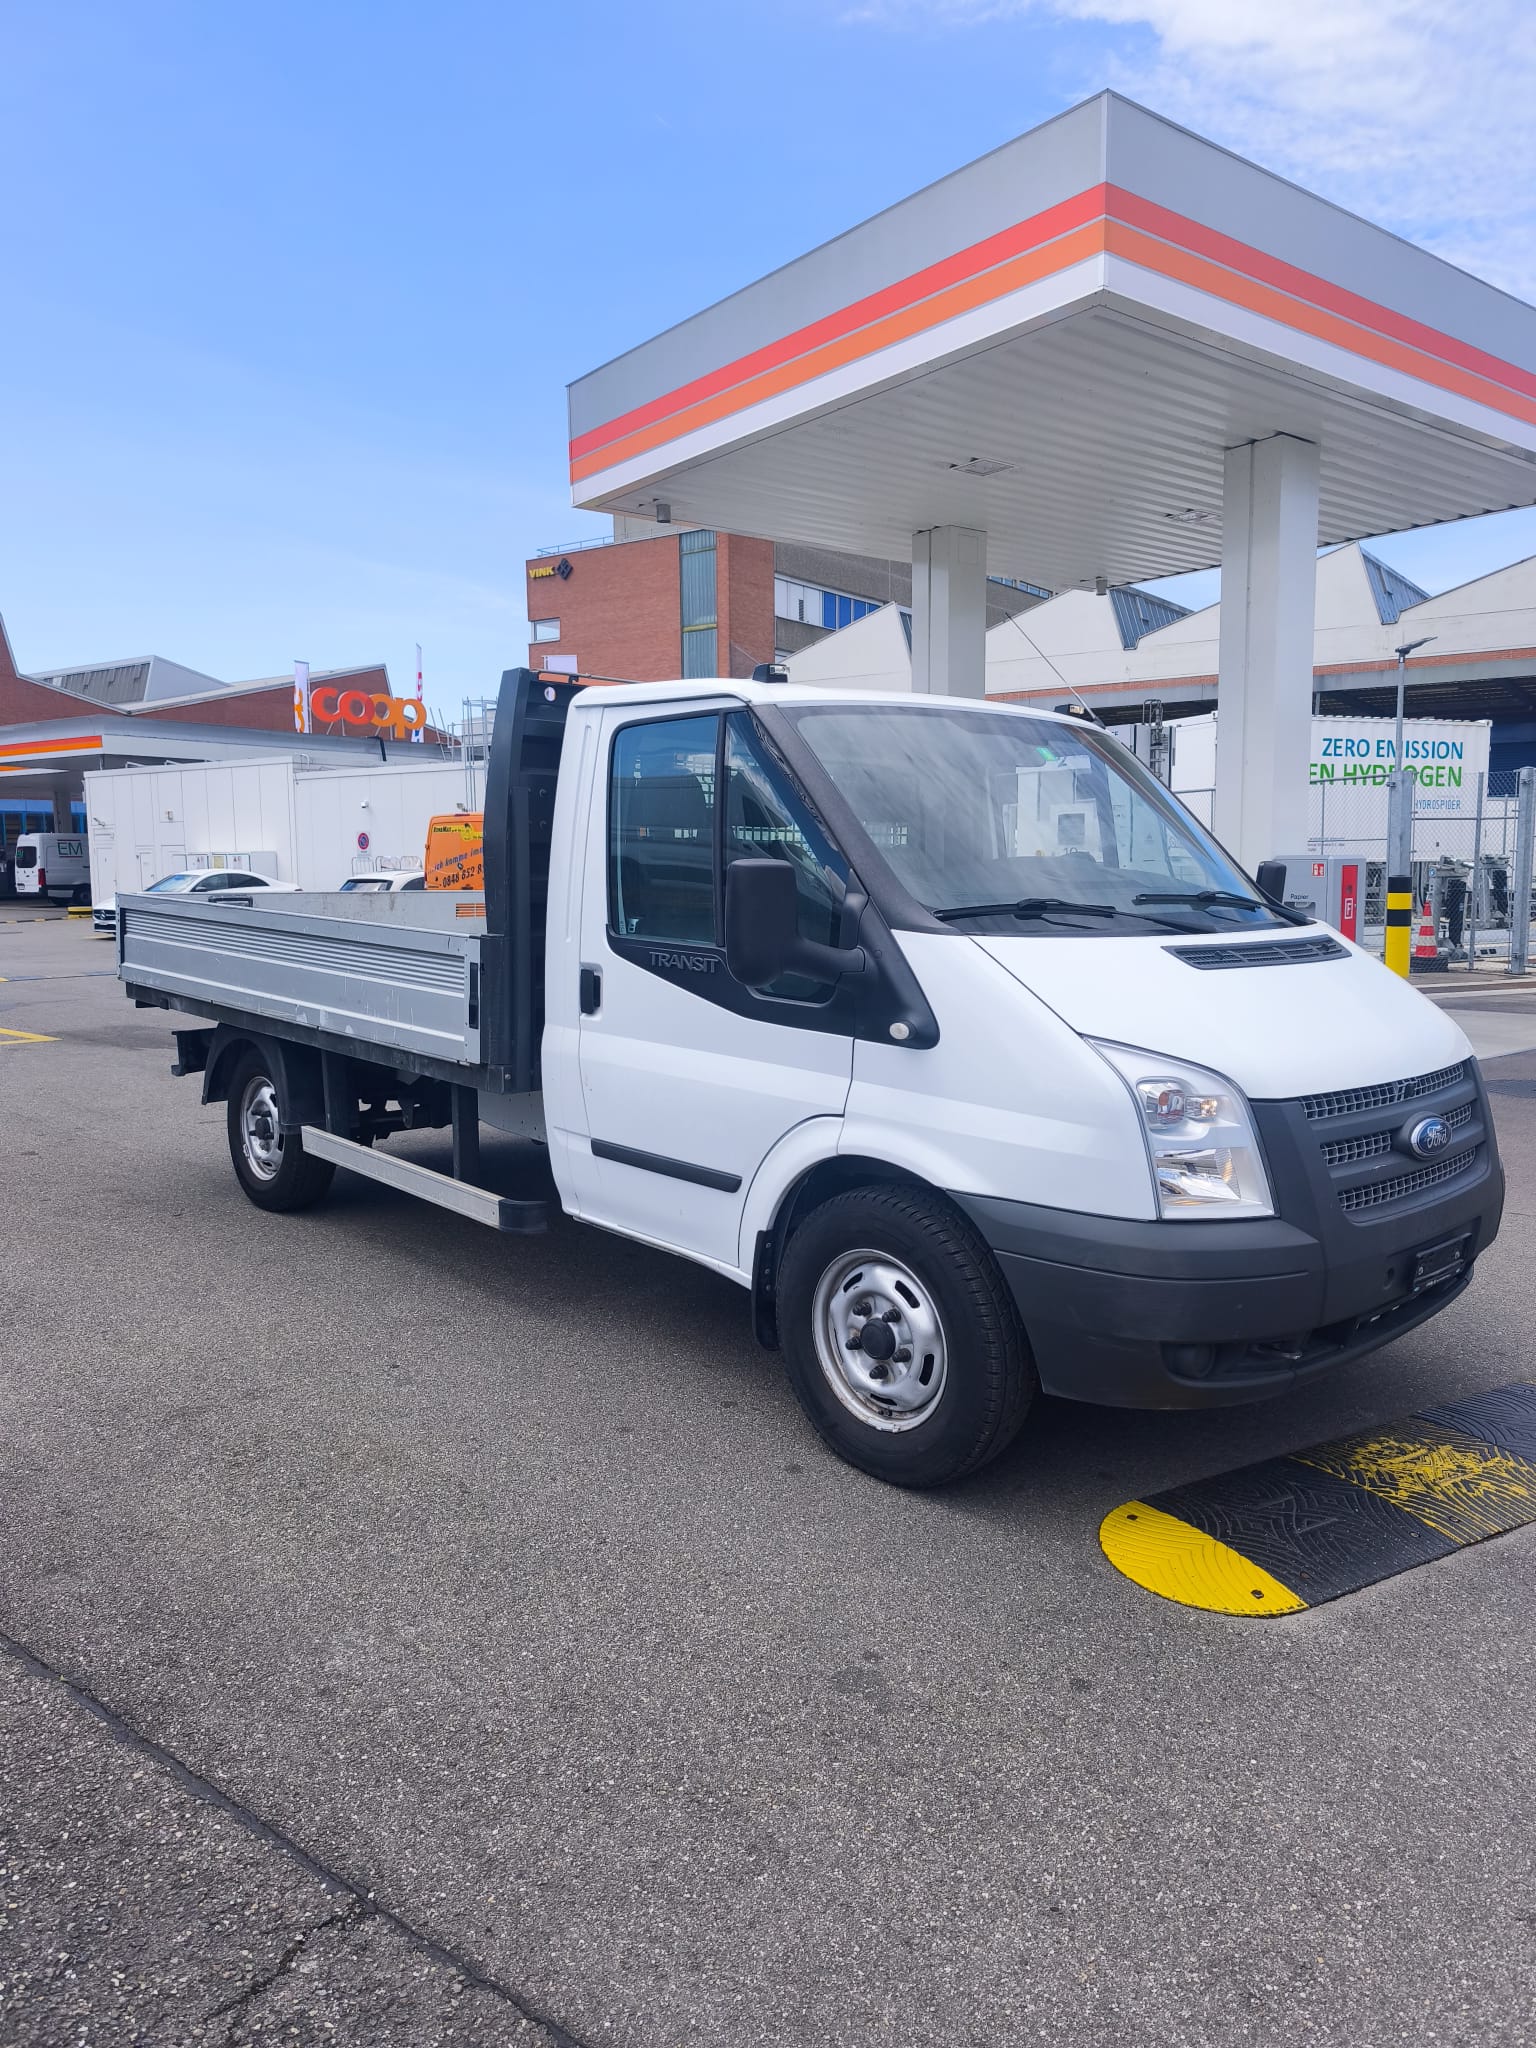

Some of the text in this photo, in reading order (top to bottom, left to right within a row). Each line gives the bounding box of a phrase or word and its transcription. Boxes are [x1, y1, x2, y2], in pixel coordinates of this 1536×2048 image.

[529, 566, 554, 578] VINK
[311, 687, 427, 738] coop
[1322, 738, 1370, 757] ZERO
[58, 842, 83, 855] EM
[443, 872, 459, 888] 0848
[649, 952, 718, 973] TRANSIT
[1425, 1125, 1448, 1149] Ford
